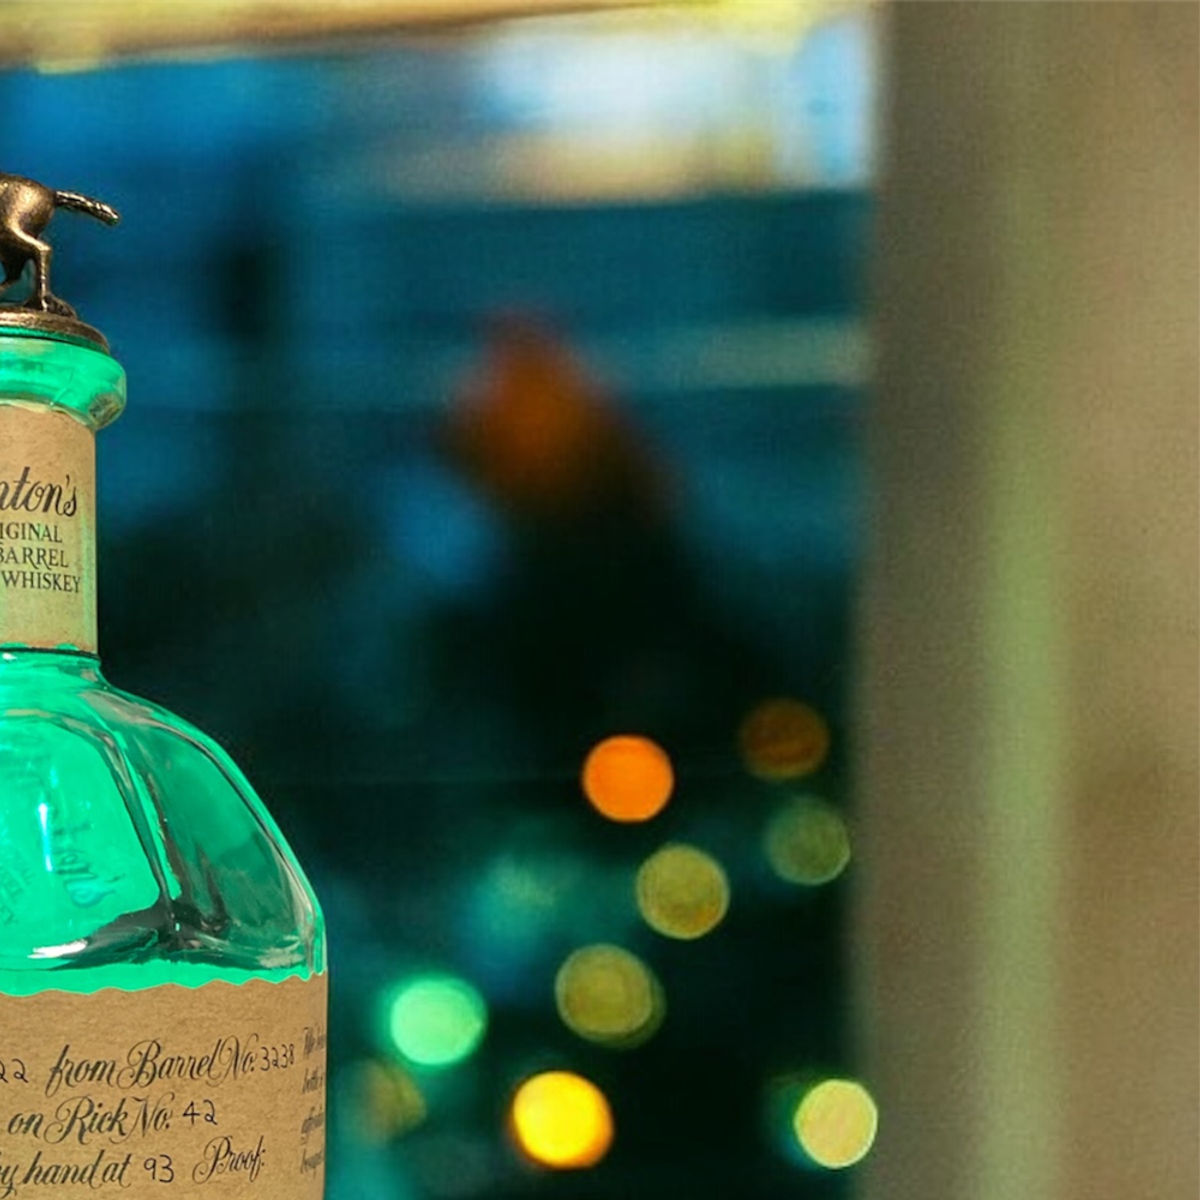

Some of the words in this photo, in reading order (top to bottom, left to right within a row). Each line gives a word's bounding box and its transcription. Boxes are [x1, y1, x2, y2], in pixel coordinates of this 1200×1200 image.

[0, 571, 81, 594] WHISKEY
[45, 1044, 117, 1097] from
[116, 1038, 221, 1090] Barrel
[6, 1110, 44, 1140] on
[43, 1096, 128, 1146] Rick
[182, 1098, 219, 1126] 42
[21, 1149, 104, 1190] hand
[101, 1152, 133, 1189] at
[142, 1154, 176, 1184] 93
